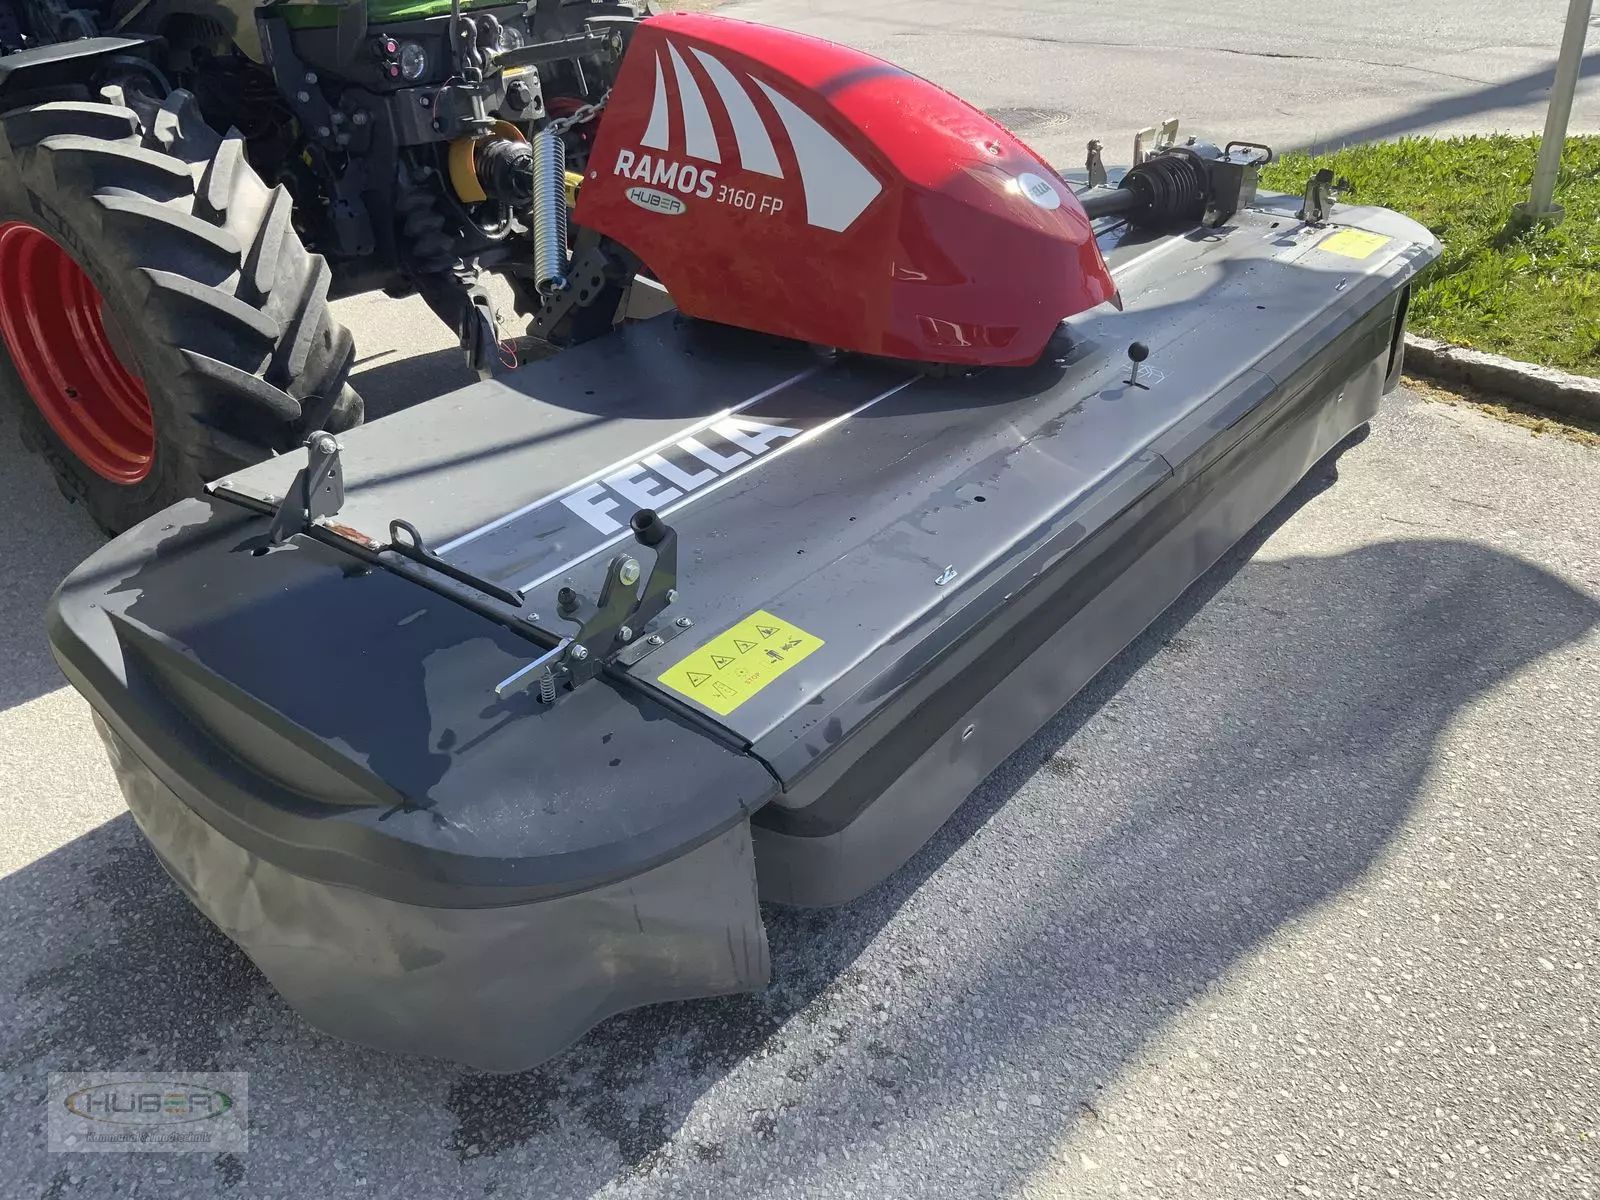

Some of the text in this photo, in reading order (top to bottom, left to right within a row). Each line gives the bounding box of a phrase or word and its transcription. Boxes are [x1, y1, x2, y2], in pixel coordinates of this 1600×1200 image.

[613, 149, 784, 216] RAMOS 3160 FP
[630, 189, 681, 213] HUBER
[560, 417, 803, 536] FELLA
[744, 672, 761, 685] STOP
